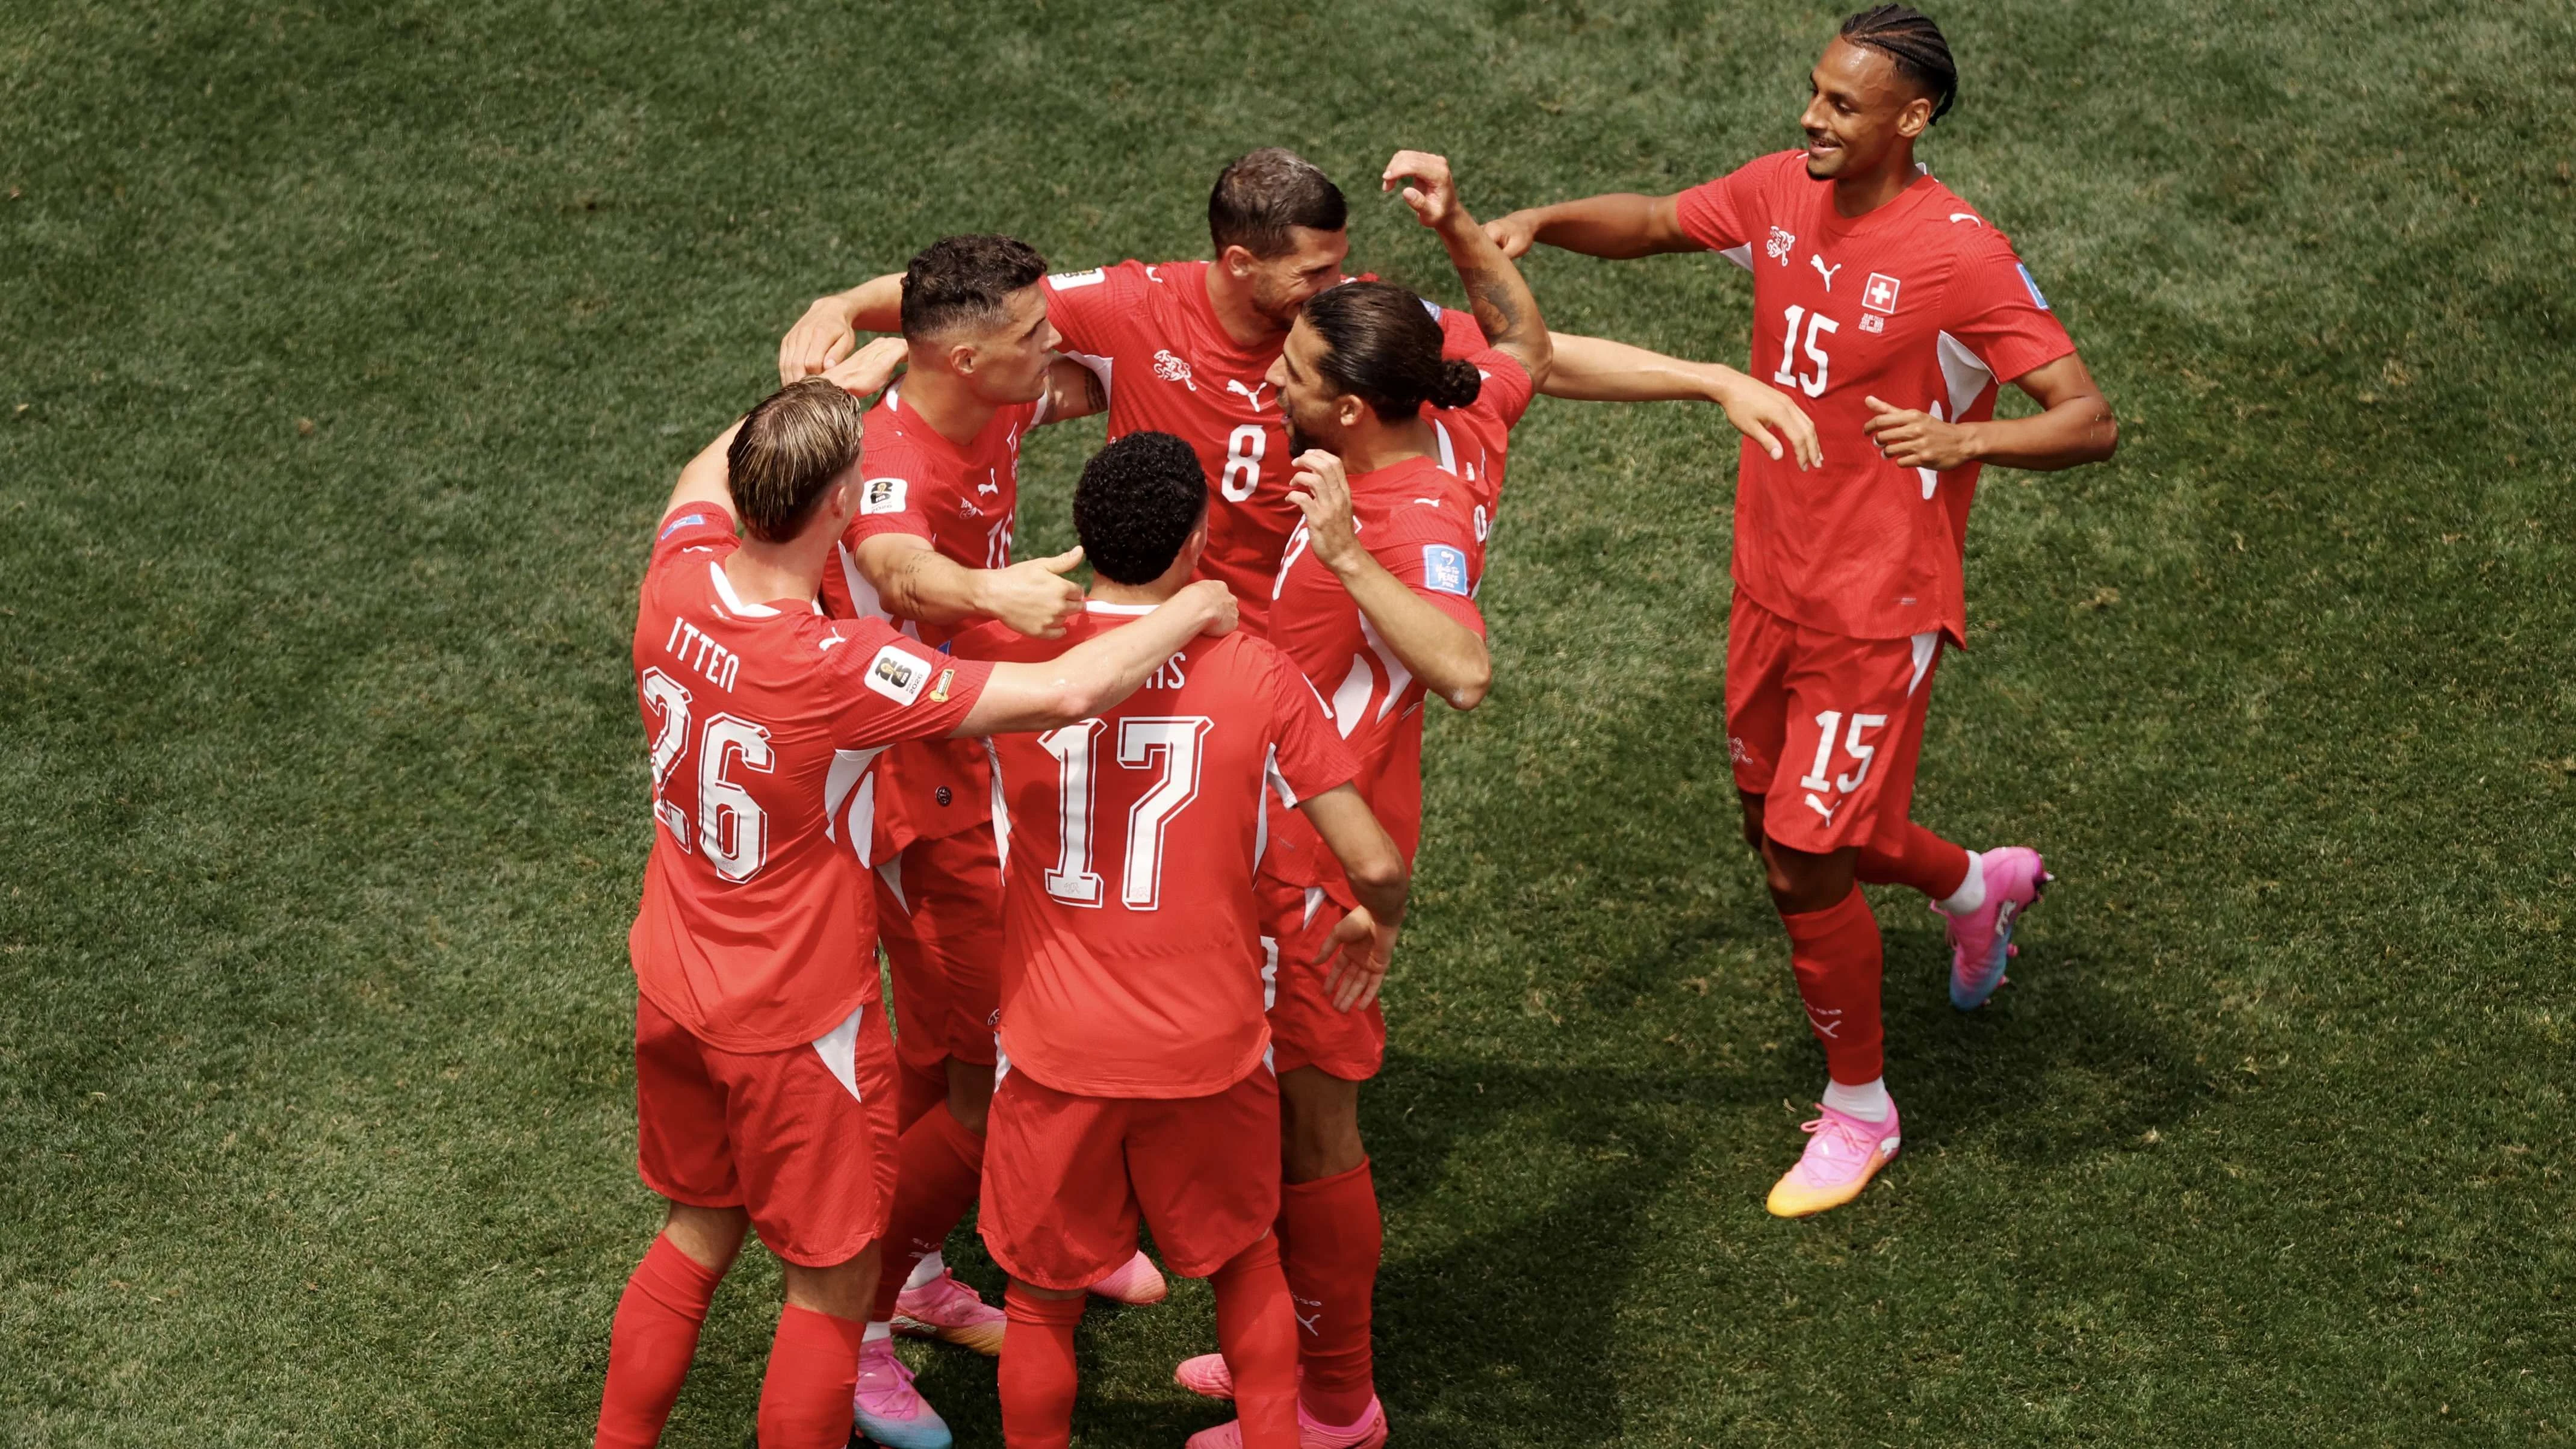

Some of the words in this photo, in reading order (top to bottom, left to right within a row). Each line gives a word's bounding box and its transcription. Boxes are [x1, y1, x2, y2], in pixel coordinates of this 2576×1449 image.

[1774, 305, 1840, 398] 15
[1221, 424, 1267, 502] 8
[666, 616, 739, 693] ITTEN
[642, 666, 775, 884] 26
[1801, 710, 1887, 793] 15
[1037, 716, 1215, 911] 17
